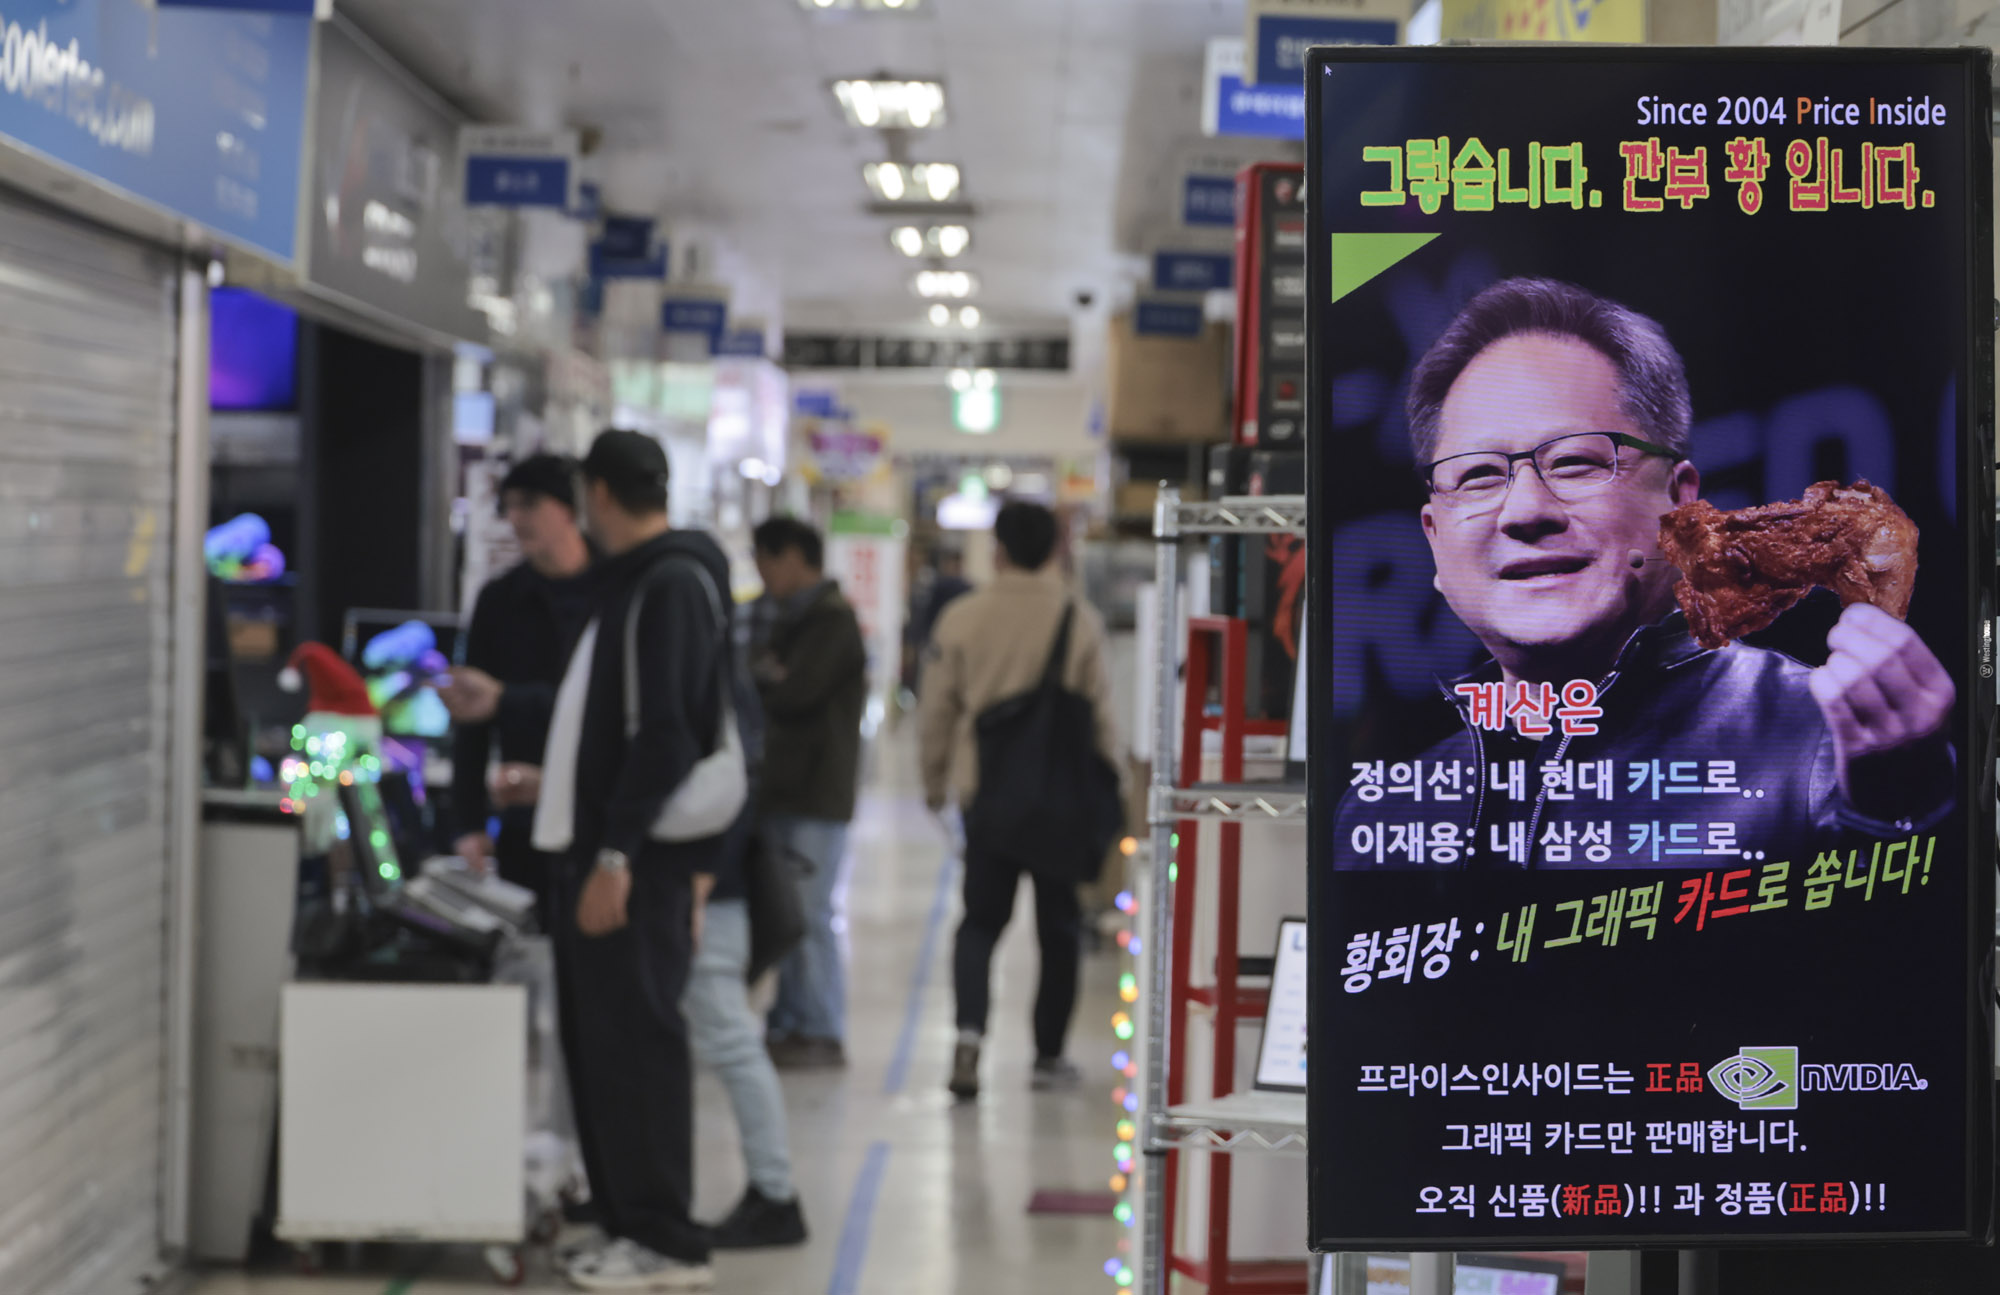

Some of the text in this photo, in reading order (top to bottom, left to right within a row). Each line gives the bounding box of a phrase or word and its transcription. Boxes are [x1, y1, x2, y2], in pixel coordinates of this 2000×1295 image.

[1637, 96, 1947, 127] Since 2004 Price Inside
[1361, 136, 1934, 215] 그렇습니다. 깐부 황 입니다.
[1455, 679, 1603, 736] 계산은
[1350, 759, 1765, 802] 정의선: 내 현대 카드로..
[1351, 820, 1765, 863] 이재용: 내 삼성 카드로..
[1496, 903, 1537, 963] 내
[1543, 881, 1664, 947] 그래픽
[1673, 861, 1790, 931] 카드로
[1803, 835, 1936, 911] 쏩니다!
[1357, 1062, 1634, 1097] 프라이스인사이드는
[1645, 1063, 1704, 1093] 正品
[1442, 1120, 1807, 1155] 그래픽 카드만 판매합니다.
[1416, 1184, 1475, 1218] 오직
[1673, 1182, 1704, 1216] 과
